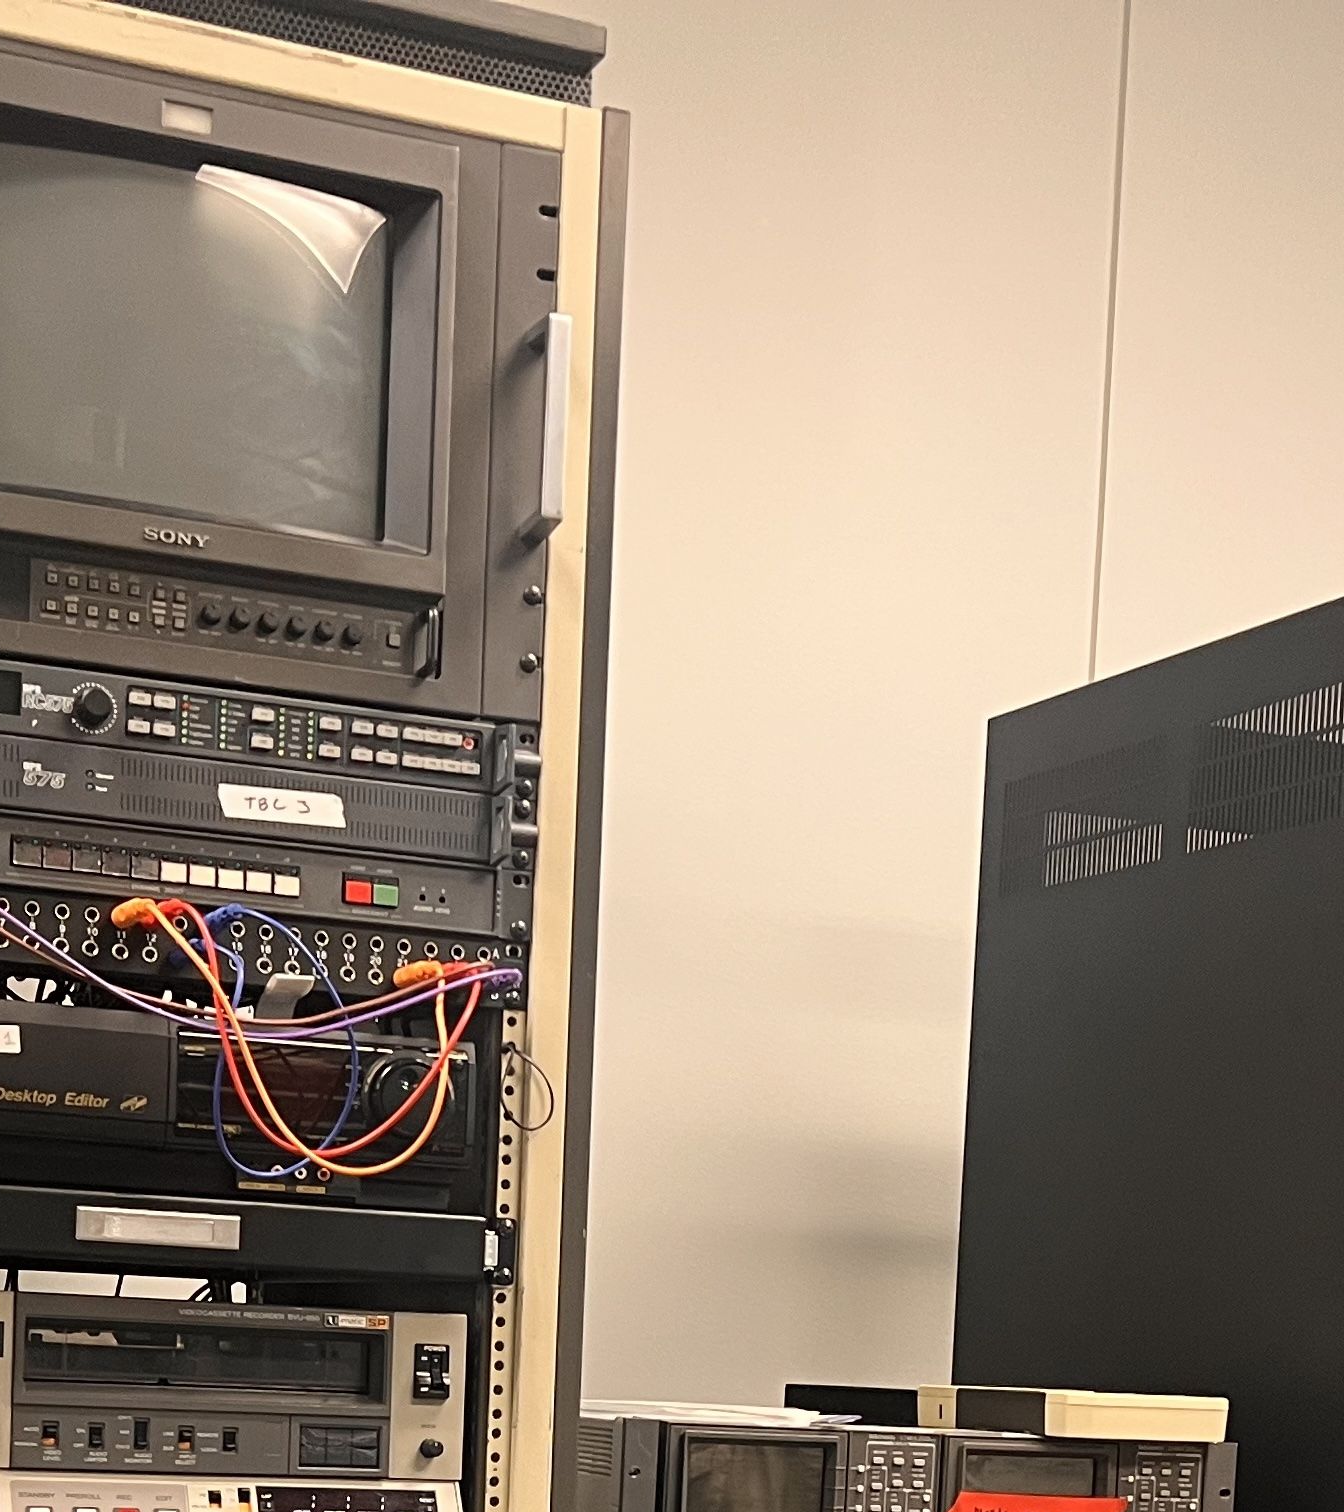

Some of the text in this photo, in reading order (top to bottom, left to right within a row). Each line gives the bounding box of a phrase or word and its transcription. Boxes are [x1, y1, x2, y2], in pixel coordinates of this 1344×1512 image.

[144, 527, 209, 548] SONY
[23, 770, 66, 789] 575
[244, 797, 286, 811] TBC
[87, 928, 99, 937] 10
[117, 931, 127, 940] 11
[146, 933, 157, 943] 12
[288, 947, 300, 957] 17
[369, 956, 382, 967] 20
[492, 948, 500, 960] A
[64, 1092, 110, 1109] Editor
[367, 1317, 388, 1328] SP
[18, 1491, 56, 1499] STANDBY
